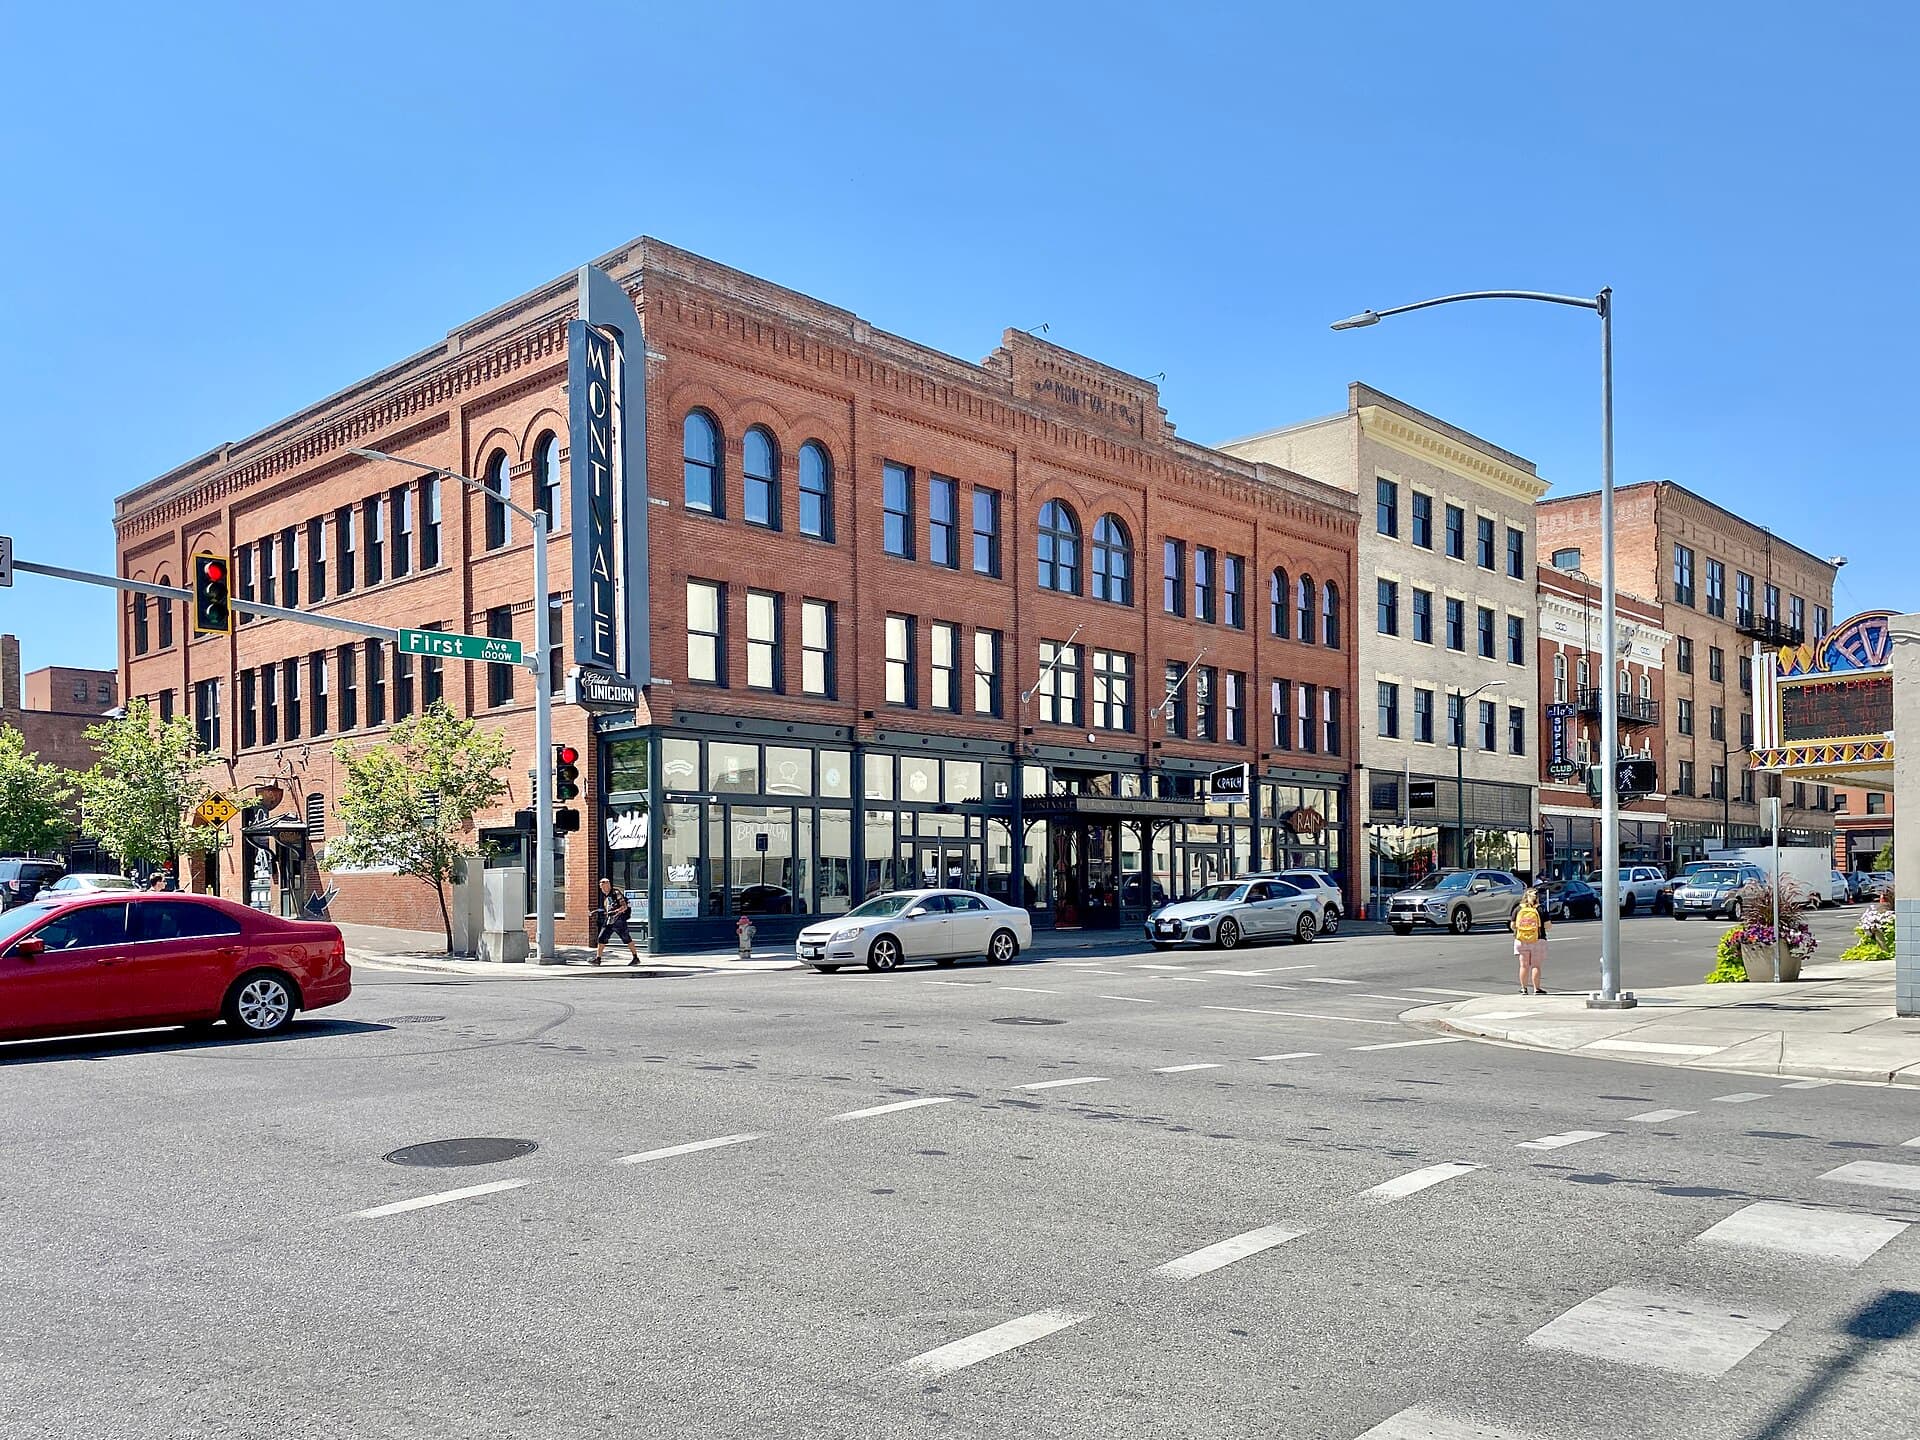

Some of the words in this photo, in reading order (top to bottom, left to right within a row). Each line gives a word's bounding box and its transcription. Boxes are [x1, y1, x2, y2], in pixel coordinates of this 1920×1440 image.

[586, 337, 610, 657] MONTVALE
[410, 633, 463, 655] First
[485, 640, 508, 652] Ave
[1835, 619, 1893, 668] FO
[481, 650, 512, 661] 1000W
[591, 684, 635, 702] UNICORN
[1554, 717, 1562, 764] SUPPER
[1550, 764, 1572, 773] CLUB
[1297, 811, 1320, 834] RAIN
